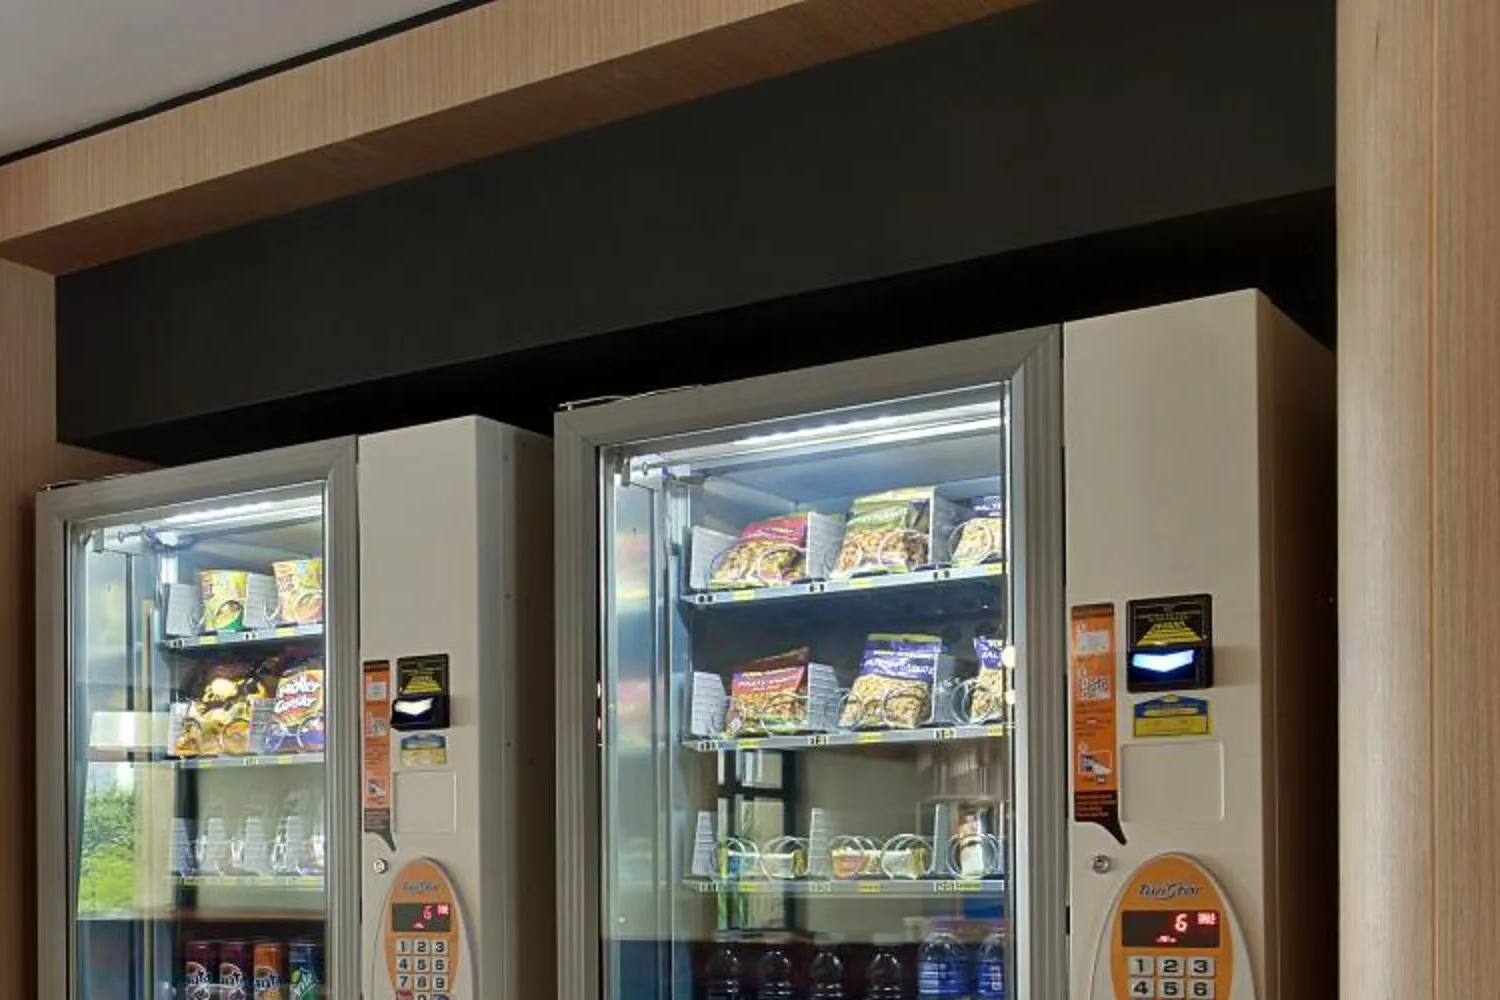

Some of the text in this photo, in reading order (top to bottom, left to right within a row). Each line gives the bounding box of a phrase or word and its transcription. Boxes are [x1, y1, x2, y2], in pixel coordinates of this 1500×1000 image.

[1174, 913, 1189, 933] 6
[399, 941, 445, 952] 1 2 3
[399, 958, 445, 970] 4 5 6
[1135, 959, 1208, 973] 1 2 3
[1133, 981, 1209, 996] 4 5 6
